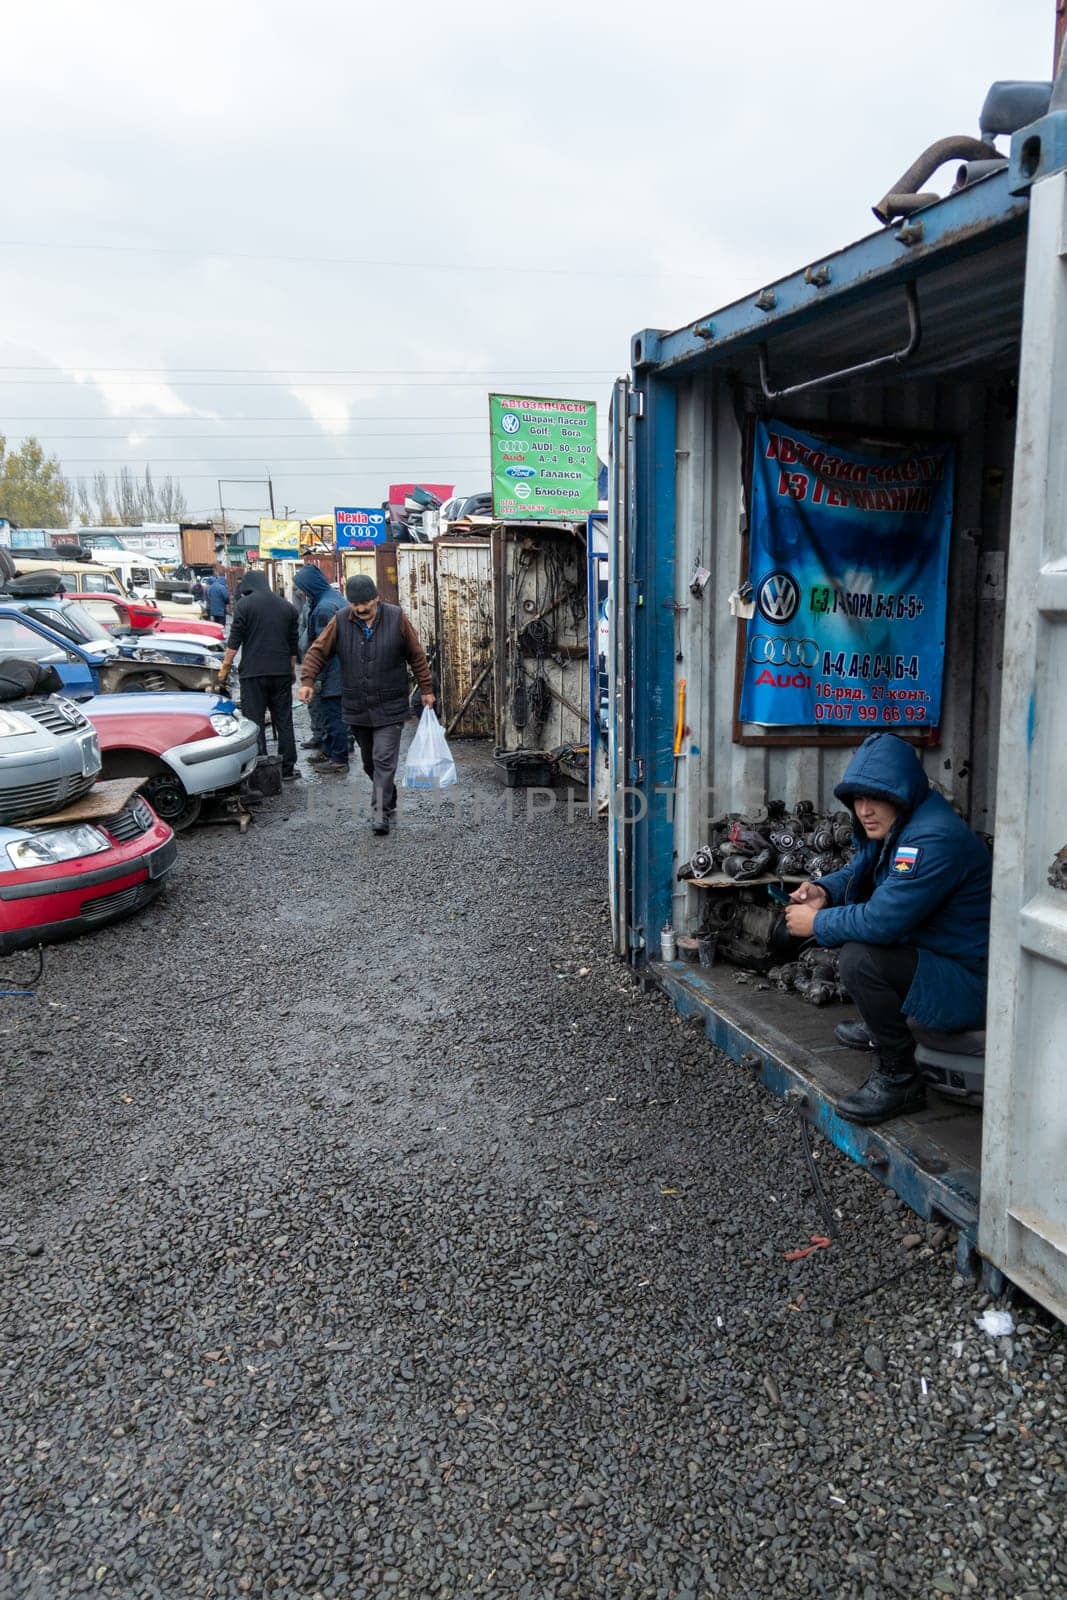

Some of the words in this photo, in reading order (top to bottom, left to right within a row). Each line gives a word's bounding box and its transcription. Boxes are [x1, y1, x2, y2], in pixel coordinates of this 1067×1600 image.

[501, 399, 586, 413] АВТОЗАПЧАСТИ
[561, 428, 581, 437] Bora
[531, 442, 553, 452] AUDI
[540, 469, 582, 479] Галакси
[535, 486, 580, 498] Блюберд
[337, 511, 369, 524] Nexia
[754, 668, 812, 689] Audi
[815, 703, 853, 720] 0707
[858, 705, 877, 721] 99
[882, 706, 901, 721] 66
[904, 706, 926, 721] 93
